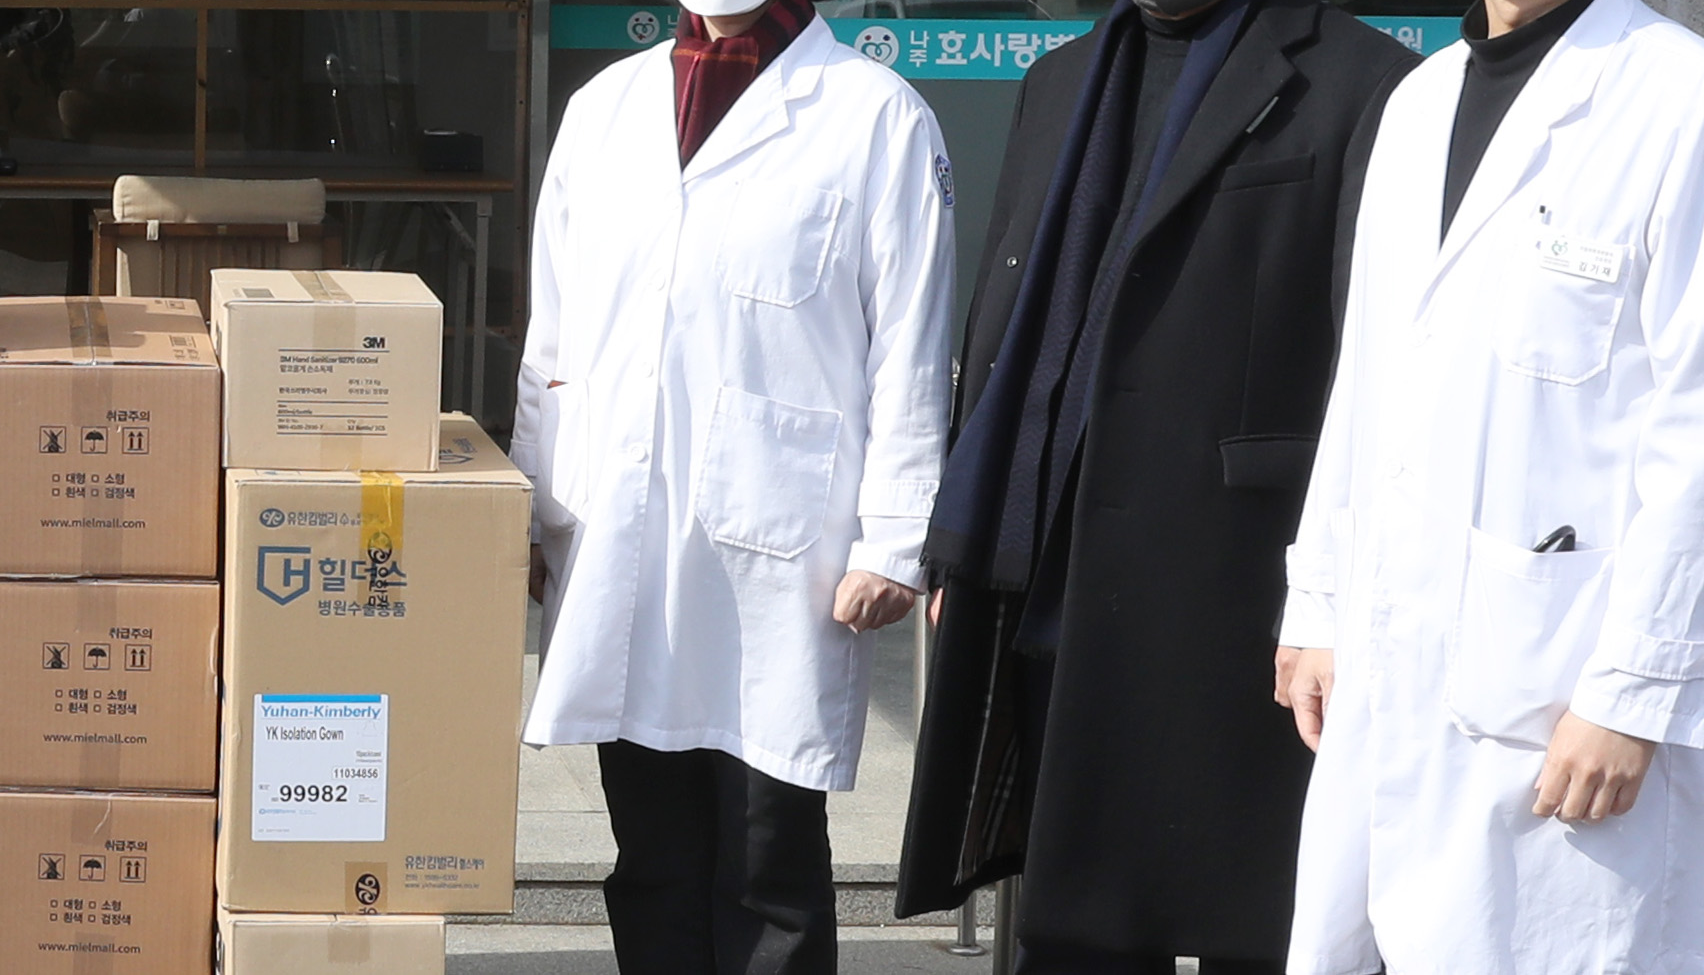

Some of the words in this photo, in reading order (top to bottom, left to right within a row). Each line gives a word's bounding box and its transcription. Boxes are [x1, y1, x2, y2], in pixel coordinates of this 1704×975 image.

[908, 30, 930, 68] 나주
[362, 336, 386, 349] 3M
[292, 356, 310, 364] Hand
[310, 356, 337, 364] Sanitizer
[106, 410, 151, 422] 취급주의
[65, 473, 86, 485] 대형
[104, 473, 125, 485] 소형
[65, 487, 86, 499] 흰색
[104, 487, 135, 499] 검정색
[40, 517, 146, 529] www.mielmall.com
[287, 511, 338, 526] 유한킴벌리
[109, 627, 153, 640] 취급주의
[68, 688, 88, 700] 대형
[106, 689, 128, 701] 소형
[68, 702, 88, 714] 흰색
[106, 702, 137, 715] 검정색
[261, 705, 382, 719] Yuhan-Kimberly
[43, 732, 148, 745] www.mielmall.com
[265, 726, 278, 740] YK
[280, 726, 316, 740] Isolation
[319, 726, 344, 741] Gown
[333, 768, 378, 779] 11034856
[279, 784, 348, 803] 99982
[104, 839, 148, 852] 취급주의
[405, 855, 457, 870] 유한킴벌리
[63, 898, 83, 910] 대형
[101, 899, 122, 911] 소형
[63, 912, 83, 924] 흰색
[101, 913, 132, 925] 검정색
[38, 941, 141, 954] www.mielmall.com
